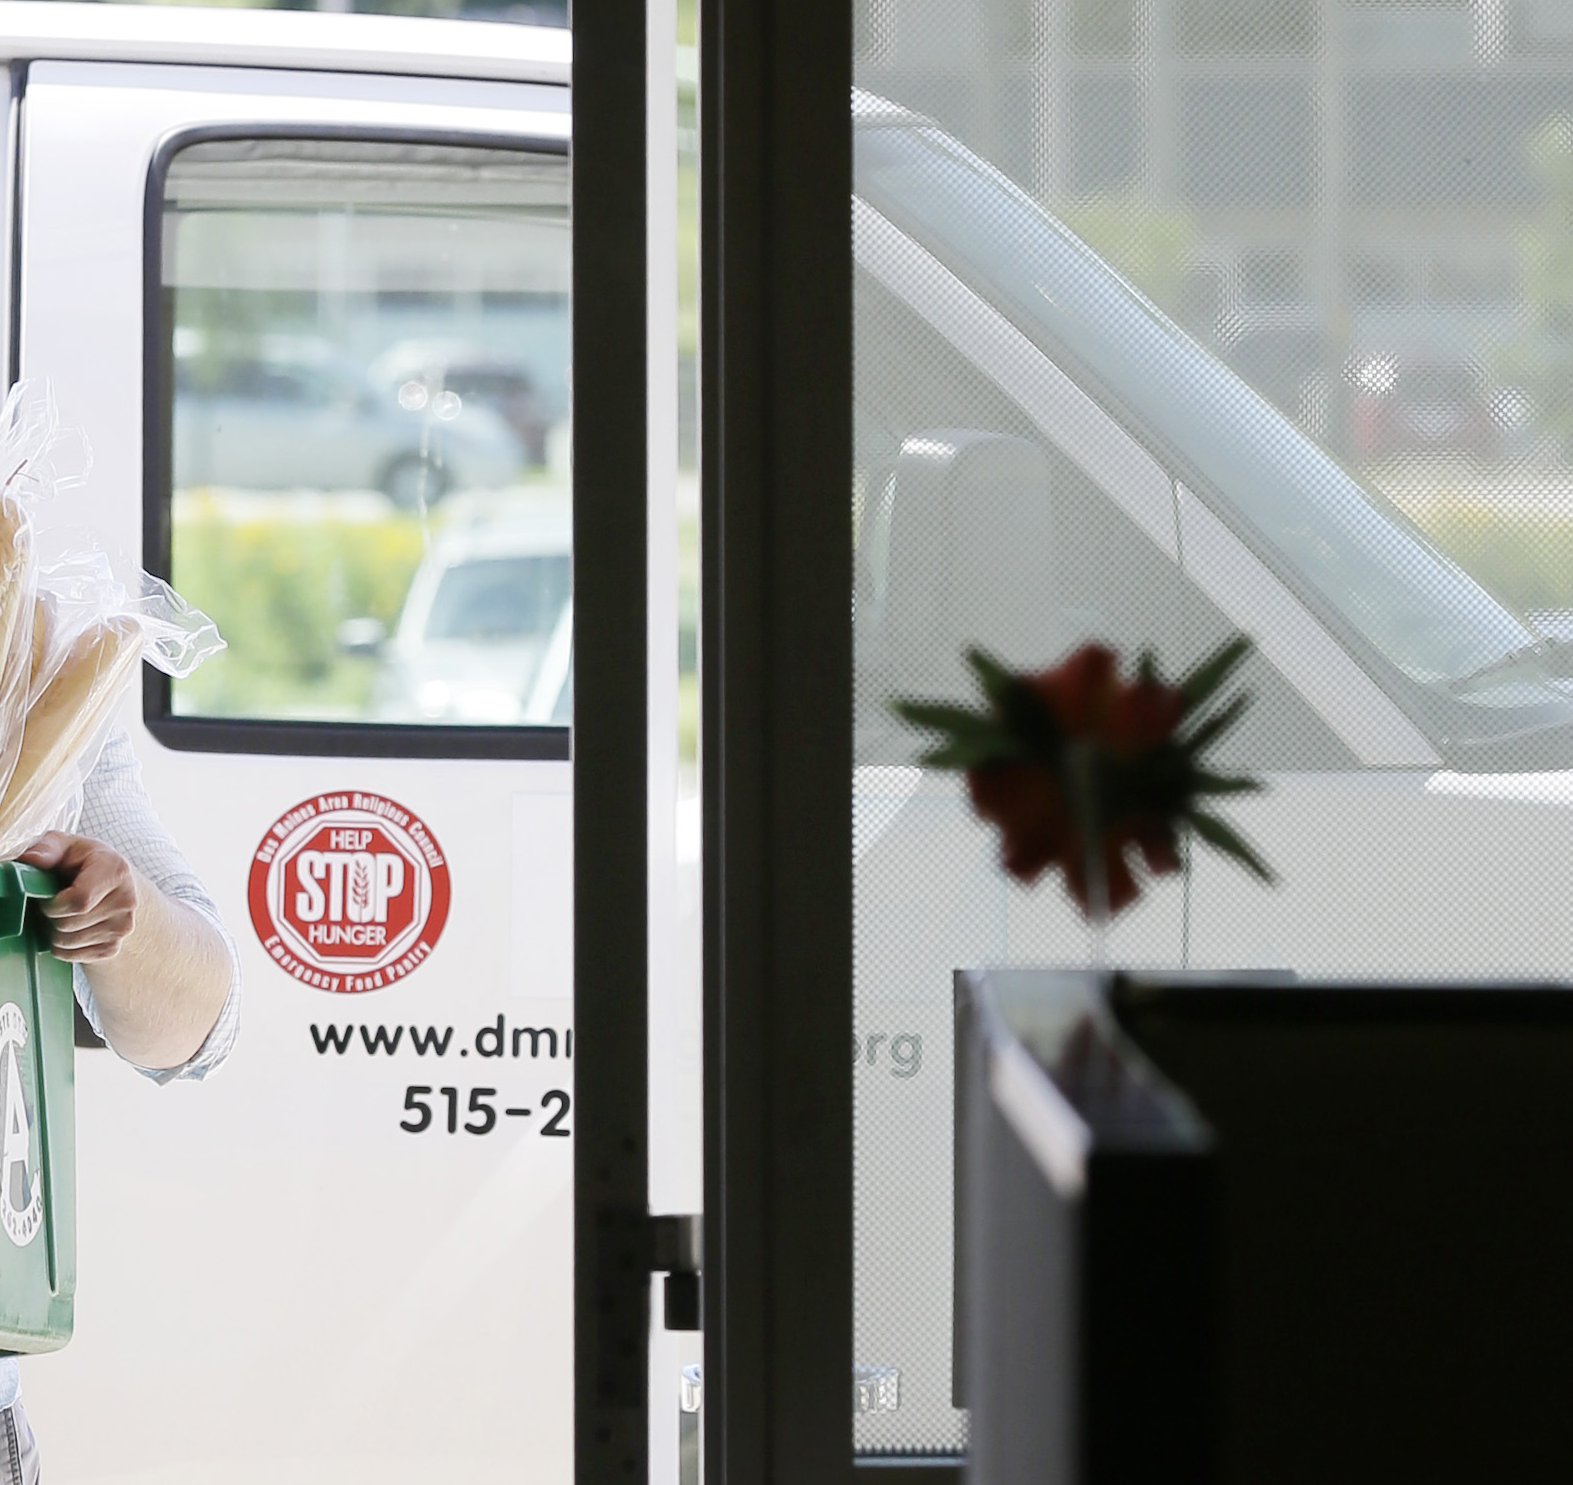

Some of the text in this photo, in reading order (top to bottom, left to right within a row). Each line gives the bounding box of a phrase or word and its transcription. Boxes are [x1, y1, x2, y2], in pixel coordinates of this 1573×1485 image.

[256, 793, 445, 869] Des Moines Area Religious Council
[329, 830, 373, 850] HELP
[295, 850, 405, 923] STOP
[308, 924, 387, 946] HUNGER
[264, 934, 432, 992] Emergency Food Pantry
[310, 1013, 573, 1058] www.dm
